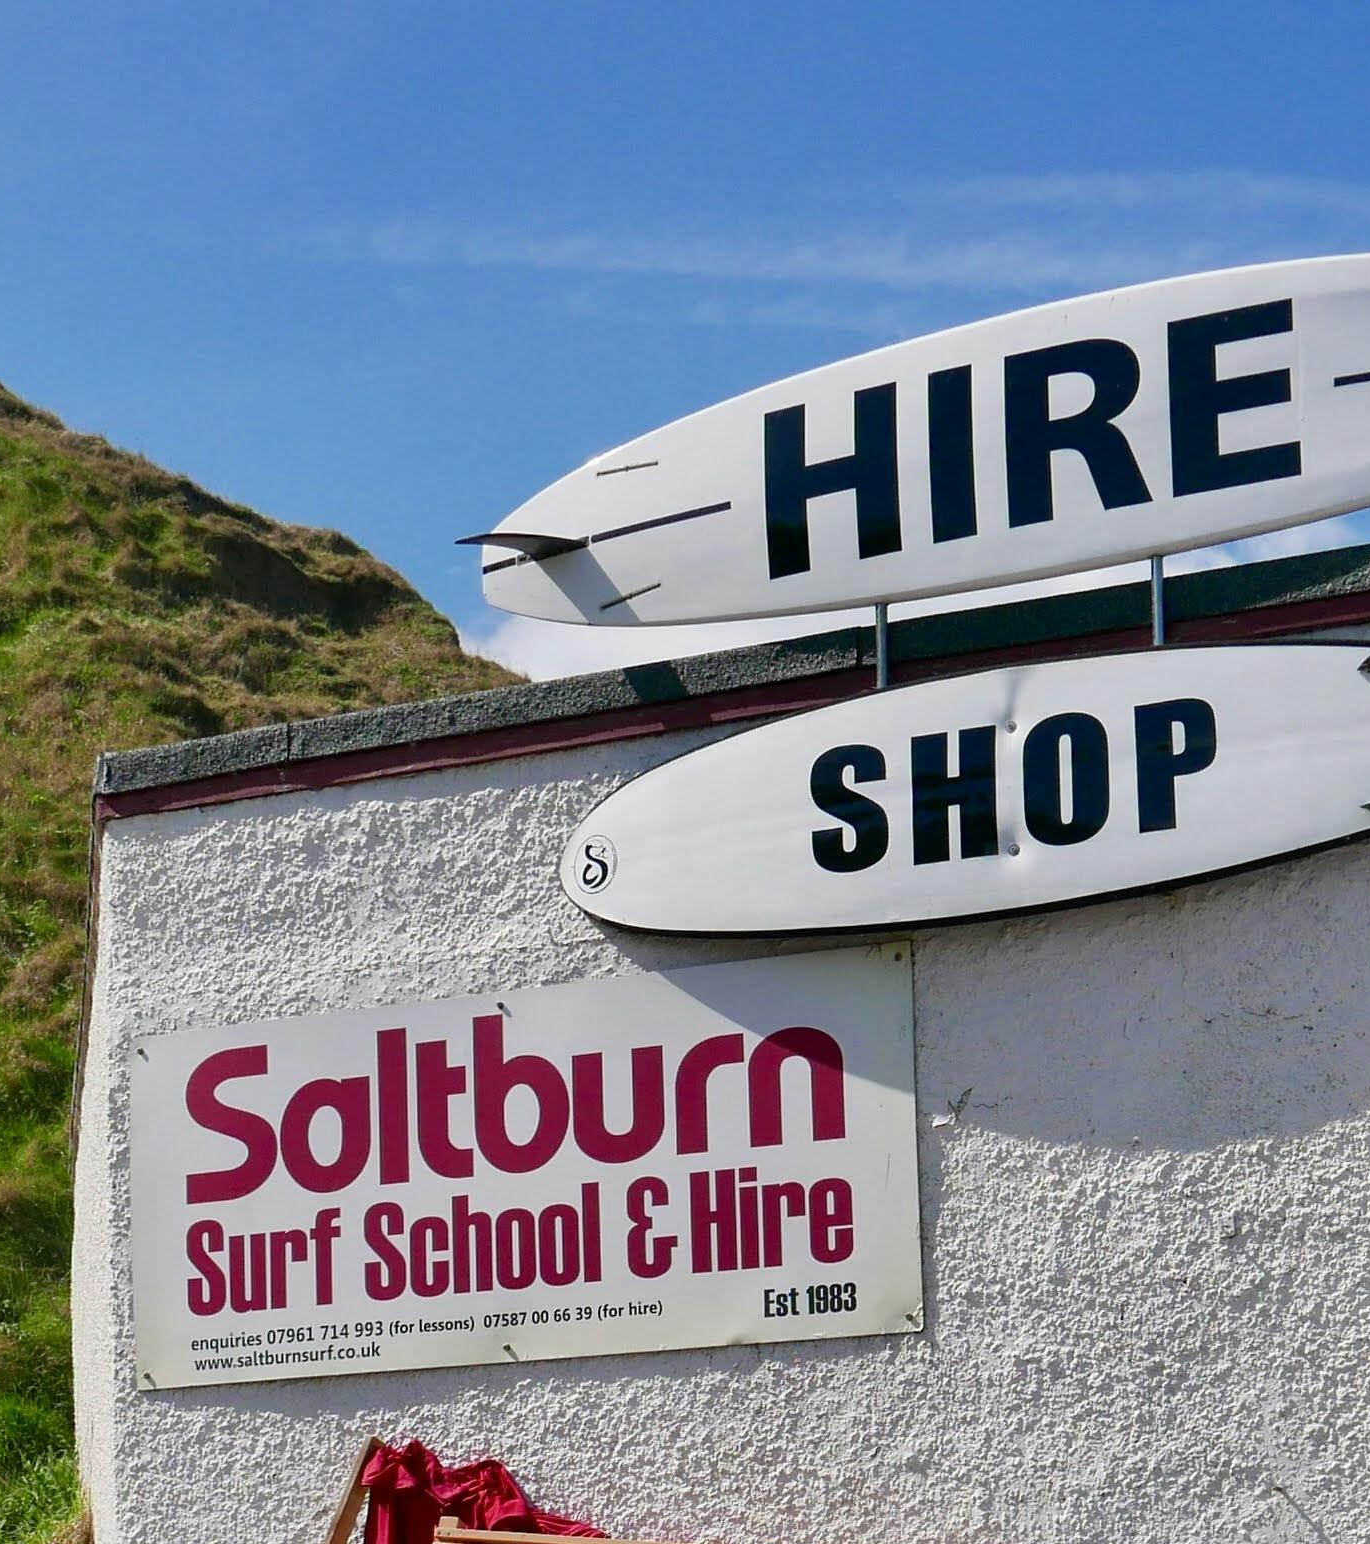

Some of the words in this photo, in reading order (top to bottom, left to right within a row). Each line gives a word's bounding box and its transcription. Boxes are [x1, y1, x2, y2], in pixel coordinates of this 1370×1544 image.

[764, 297, 1303, 582] HIRE
[809, 696, 1217, 875] SHOP
[185, 1014, 847, 1204] Saltburn
[186, 1207, 342, 1317] Surf
[364, 1181, 600, 1302] School
[627, 1176, 677, 1279] &
[689, 1166, 855, 1275] Hire
[763, 1289, 799, 1319] Est
[806, 1282, 857, 1316] 1983
[191, 1332, 262, 1354] enquiries
[267, 1326, 315, 1344] 07961
[320, 1324, 349, 1340] 714
[354, 1321, 383, 1338] 993
[389, 1319, 415, 1337] (for
[419, 1316, 475, 1333] lessons)
[483, 1312, 527, 1328] 07587
[531, 1310, 549, 1324] 00
[553, 1308, 571, 1322] 66
[575, 1306, 593, 1321] 39
[597, 1304, 625, 1321] (for
[628, 1300, 663, 1316] hire)
[194, 1342, 381, 1371] www.saltburnsurf.co.uk
